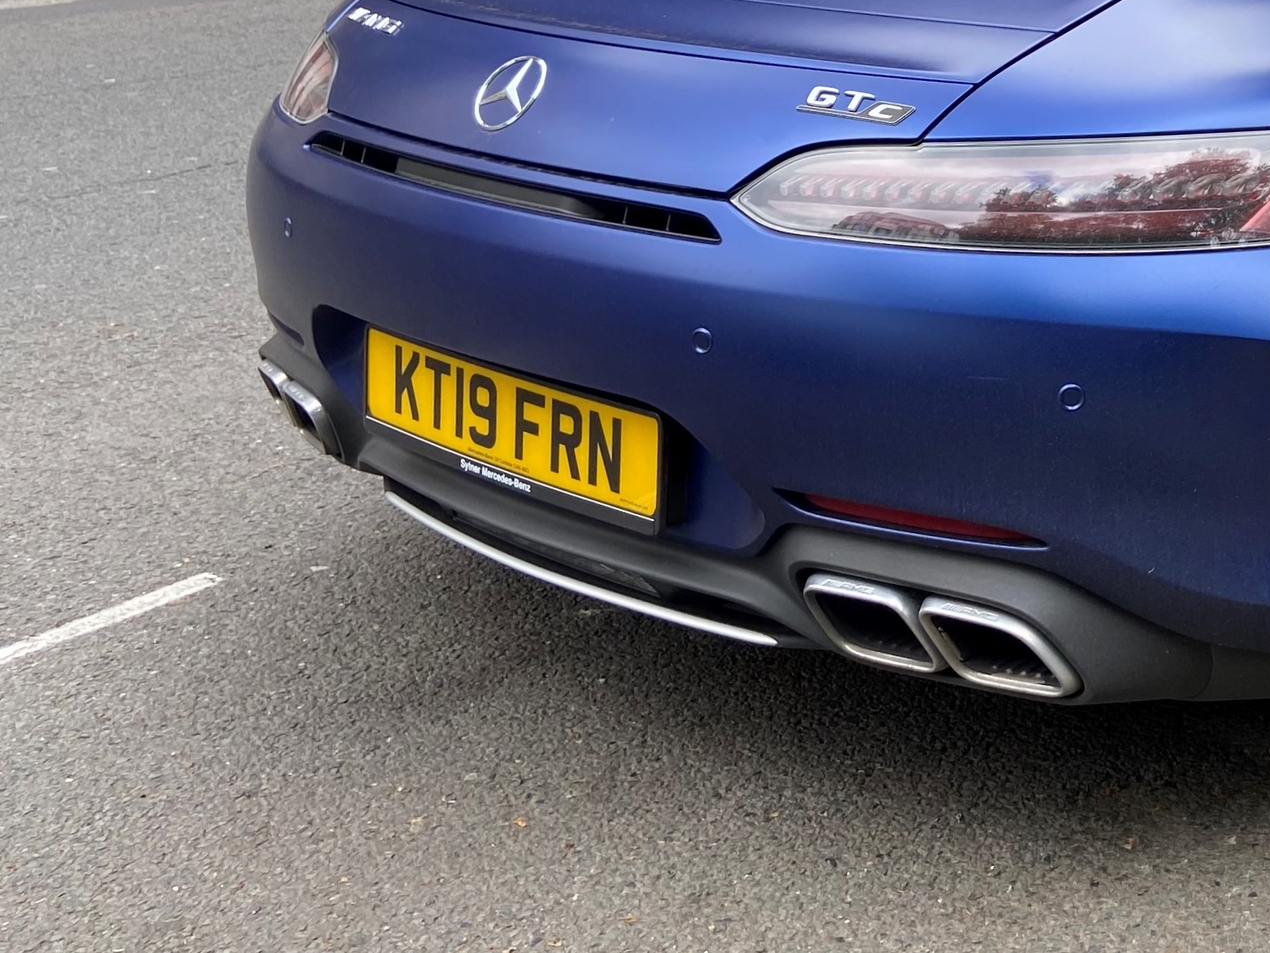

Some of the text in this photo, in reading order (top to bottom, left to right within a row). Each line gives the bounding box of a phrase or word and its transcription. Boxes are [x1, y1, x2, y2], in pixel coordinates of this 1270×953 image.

[394, 344, 622, 494] KT19 FRN
[482, 467, 531, 492] Mercedes-Benz
